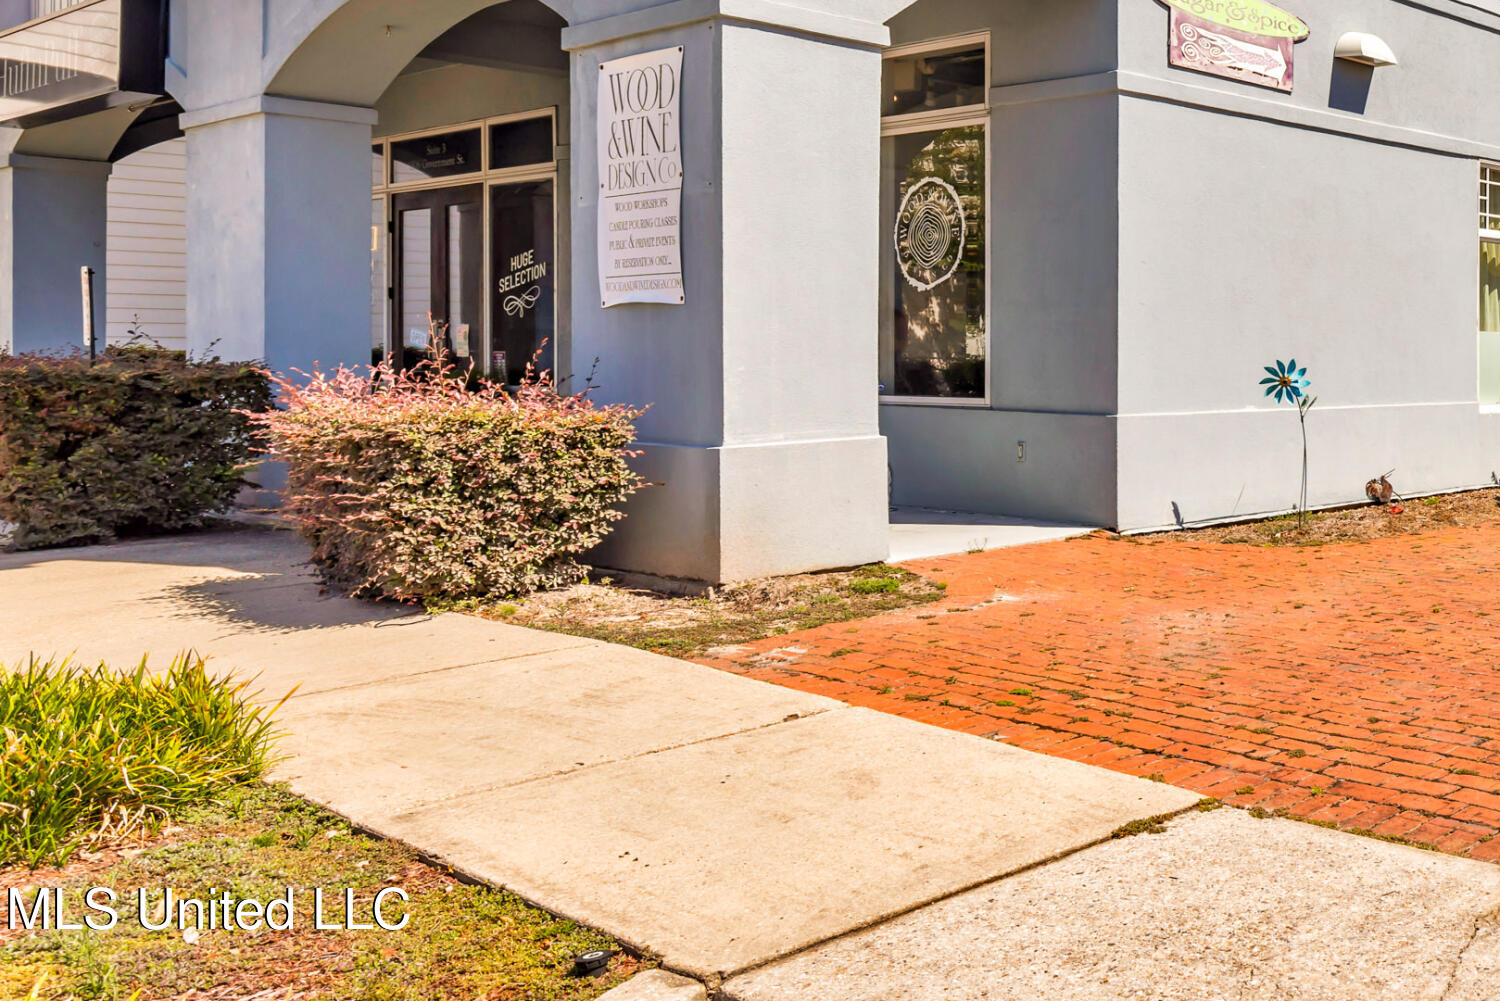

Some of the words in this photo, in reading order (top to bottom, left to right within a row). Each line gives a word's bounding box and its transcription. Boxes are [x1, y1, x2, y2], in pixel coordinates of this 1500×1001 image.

[1225, 0, 1247, 21] &
[1247, 6, 1300, 35] Spice
[608, 63, 676, 115] WOOD
[608, 159, 656, 191] DESIGN
[615, 201, 633, 212] WOOD
[634, 197, 668, 210] WORKSHOPS
[654, 215, 678, 228] CLASSES
[608, 239, 627, 251] PUBLIC
[628, 233, 635, 249] &
[635, 236, 655, 248] PRIVATE
[655, 235, 676, 246] EVENTS
[510, 249, 535, 272] HUGE
[498, 261, 546, 293] SELECTION
